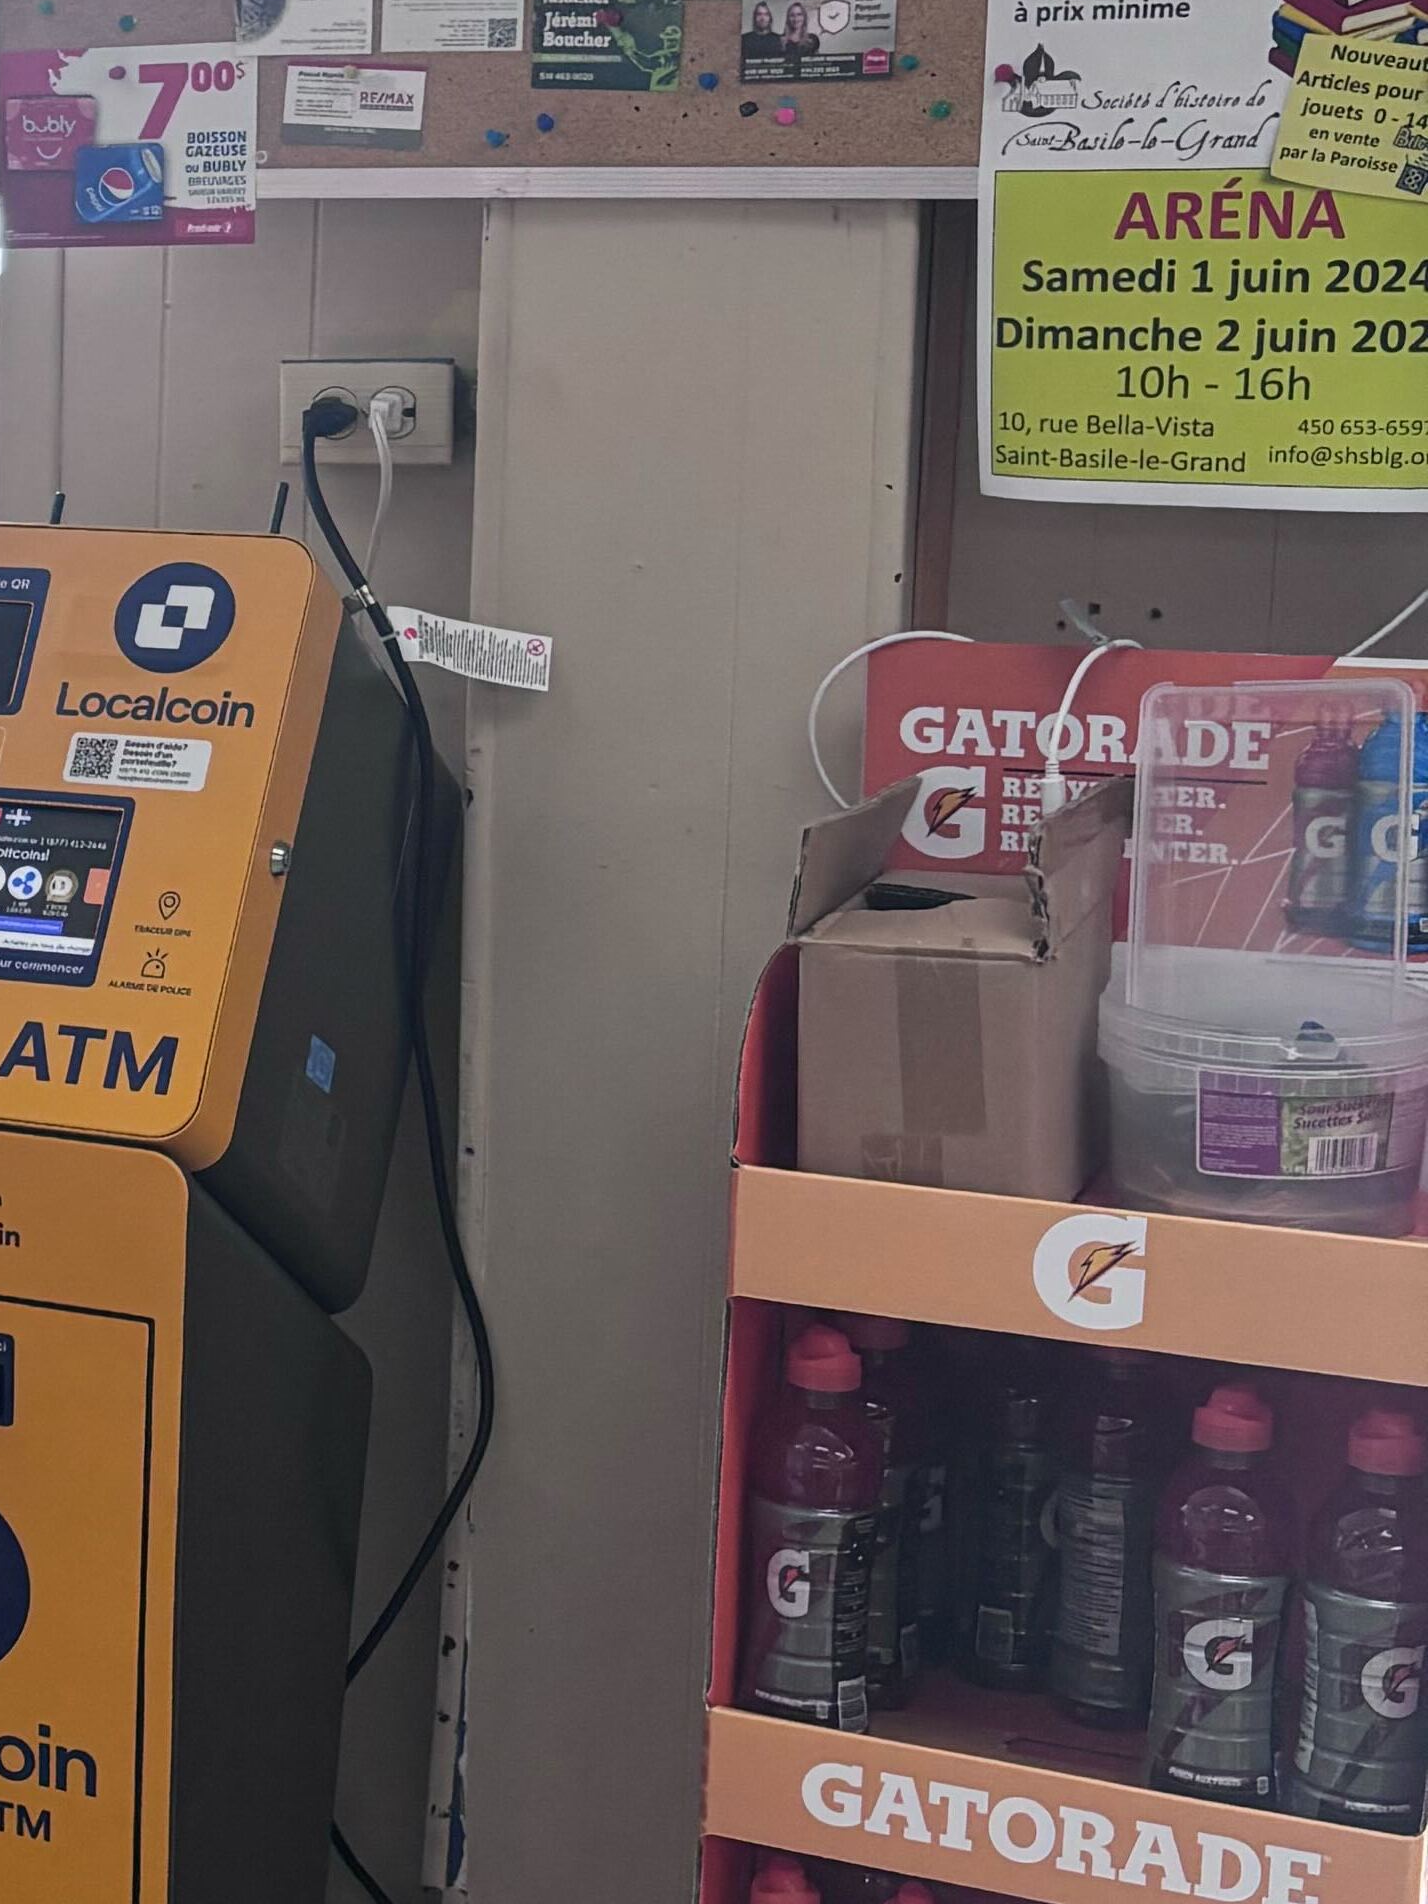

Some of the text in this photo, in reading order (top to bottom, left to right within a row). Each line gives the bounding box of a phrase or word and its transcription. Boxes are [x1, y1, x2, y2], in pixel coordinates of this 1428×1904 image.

[544, 10, 599, 33] Jérémi
[1014, 1, 1029, 23] à
[1036, 0, 1084, 27] prix
[543, 30, 612, 50] Boucher
[1296, 70, 1424, 101] Articles pour
[185, 144, 248, 158] GAZEUSE
[186, 131, 247, 144] BOISSON
[1279, 146, 1398, 174] par la Paroisse
[1113, 177, 1346, 241] ARÉNA
[1021, 257, 1428, 302] Samedi 1 juin 2024
[996, 316, 1202, 352] Dimanche
[1216, 319, 1240, 353] 2
[1251, 318, 1337, 361] juin
[1116, 364, 1312, 401] 10h 16h
[998, 411, 1334, 438] 10, rue Bella-Vista 450
[996, 444, 1246, 474] Saint-Basile-le-Grand
[11, 577, 32, 592] QR
[55, 681, 255, 728] Localcoin
[1031, 1212, 1148, 1331] G
